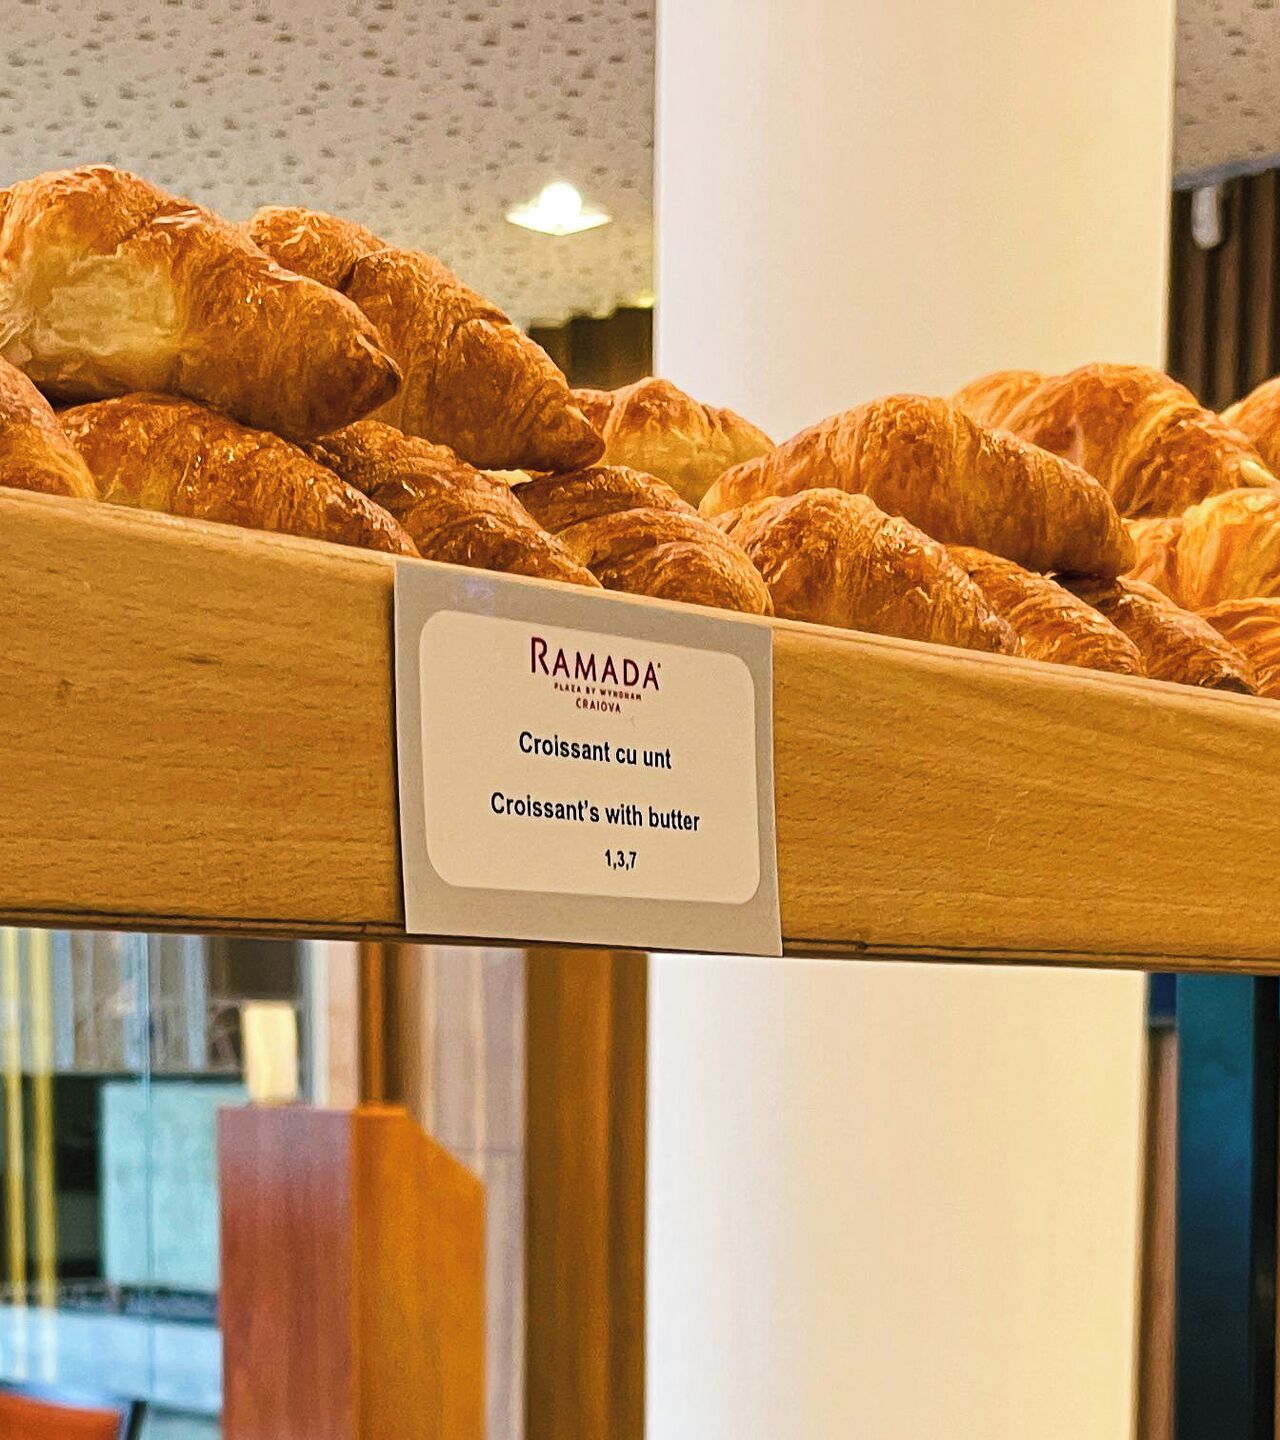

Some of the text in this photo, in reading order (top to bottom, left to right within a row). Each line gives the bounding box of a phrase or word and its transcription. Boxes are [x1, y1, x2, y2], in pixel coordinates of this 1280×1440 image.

[531, 636, 659, 690] RAMADA
[554, 682, 581, 694] PLAZA
[586, 685, 596, 695] BY
[575, 697, 621, 714] CRAIOVA
[519, 731, 672, 769] Croissant cu unt
[491, 792, 700, 832] Croissant's with butter
[605, 849, 637, 871] 1,3,7
